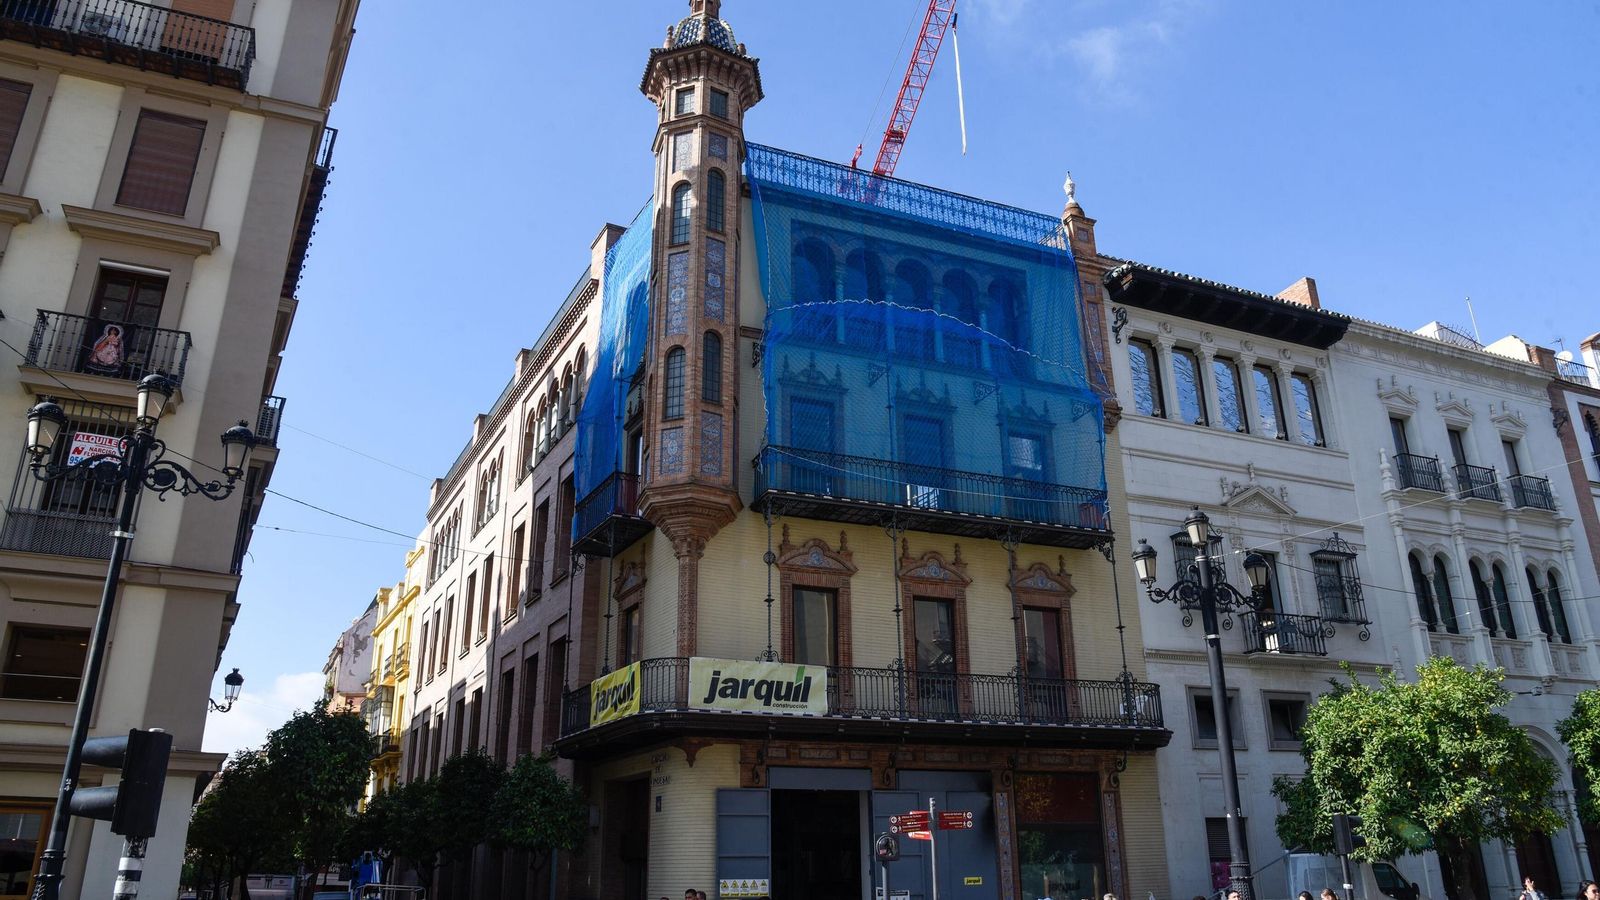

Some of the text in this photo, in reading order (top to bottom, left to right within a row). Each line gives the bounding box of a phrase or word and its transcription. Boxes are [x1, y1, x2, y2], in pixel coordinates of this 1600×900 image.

[88, 446, 117, 456] NARCISO
[593, 665, 635, 721] jarquil
[703, 666, 812, 706] jarquil
